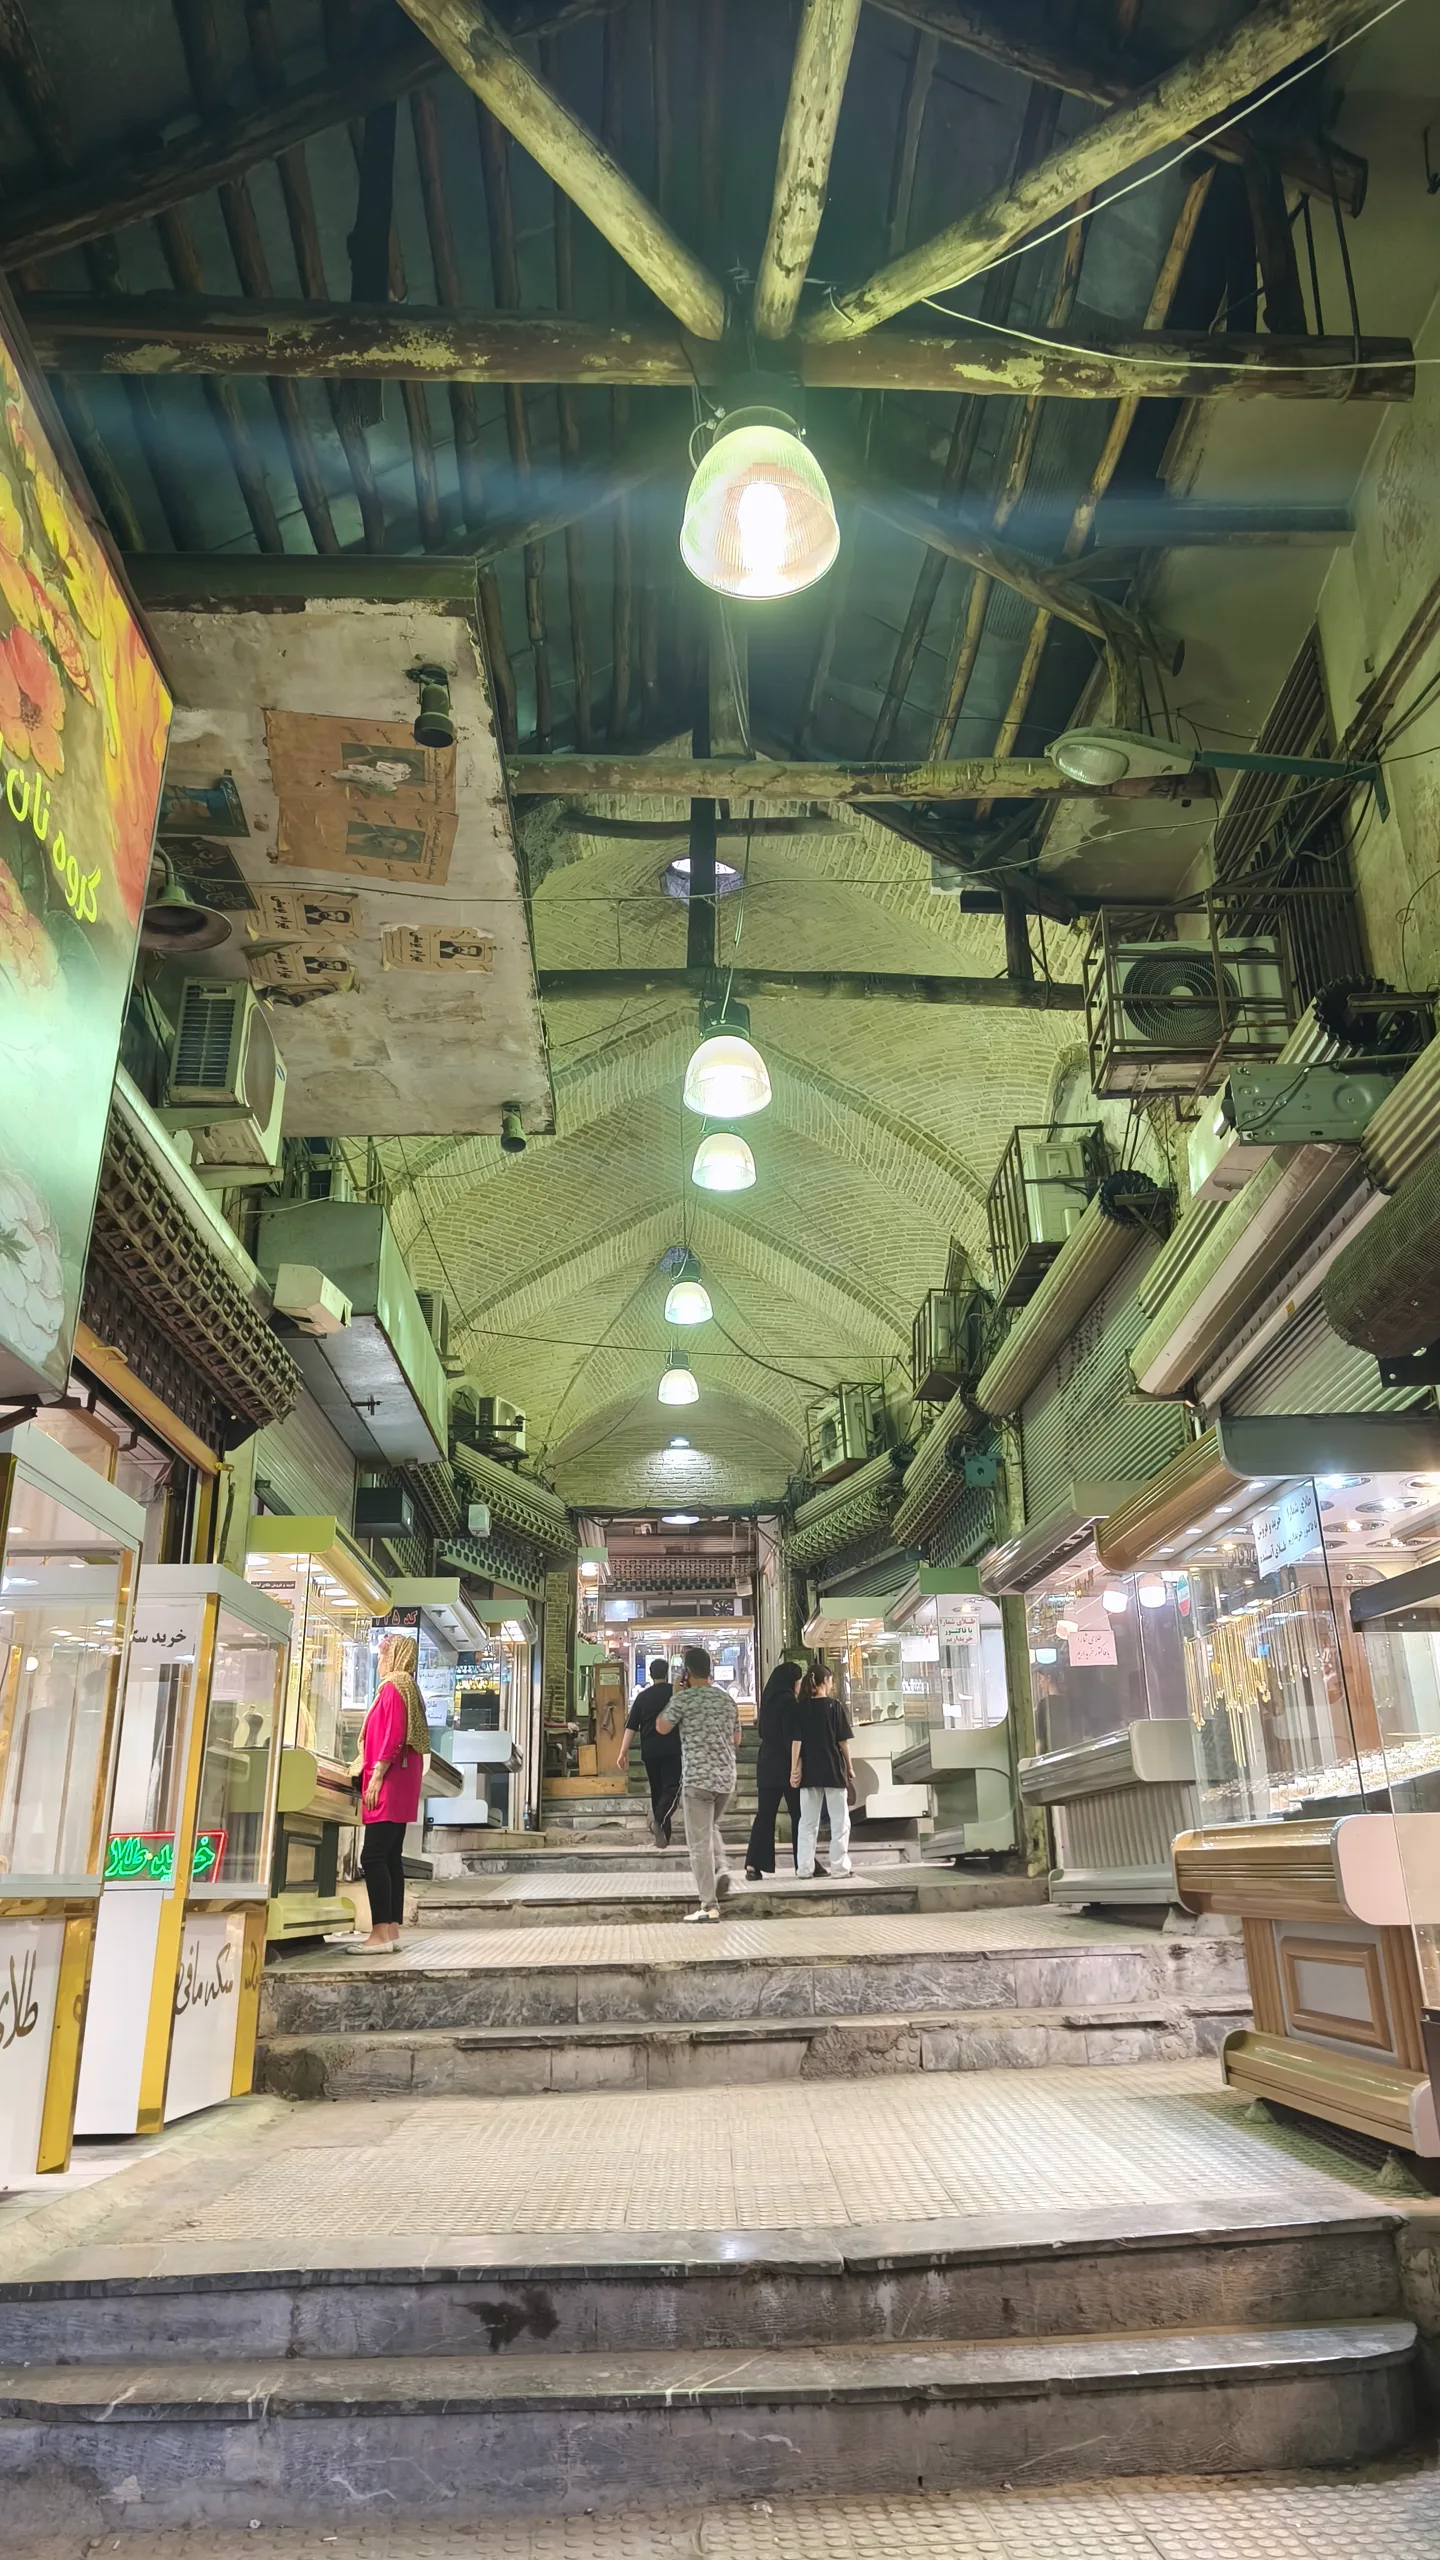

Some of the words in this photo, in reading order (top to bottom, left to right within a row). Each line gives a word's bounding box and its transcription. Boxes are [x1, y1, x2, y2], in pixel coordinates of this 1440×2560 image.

[403, 1610, 418, 1625] کد
[956, 1617, 976, 1626] طلای
[152, 1629, 187, 1648] خرید
[104, 1836, 149, 1877] طلا
[151, 1835, 216, 1882] خید
